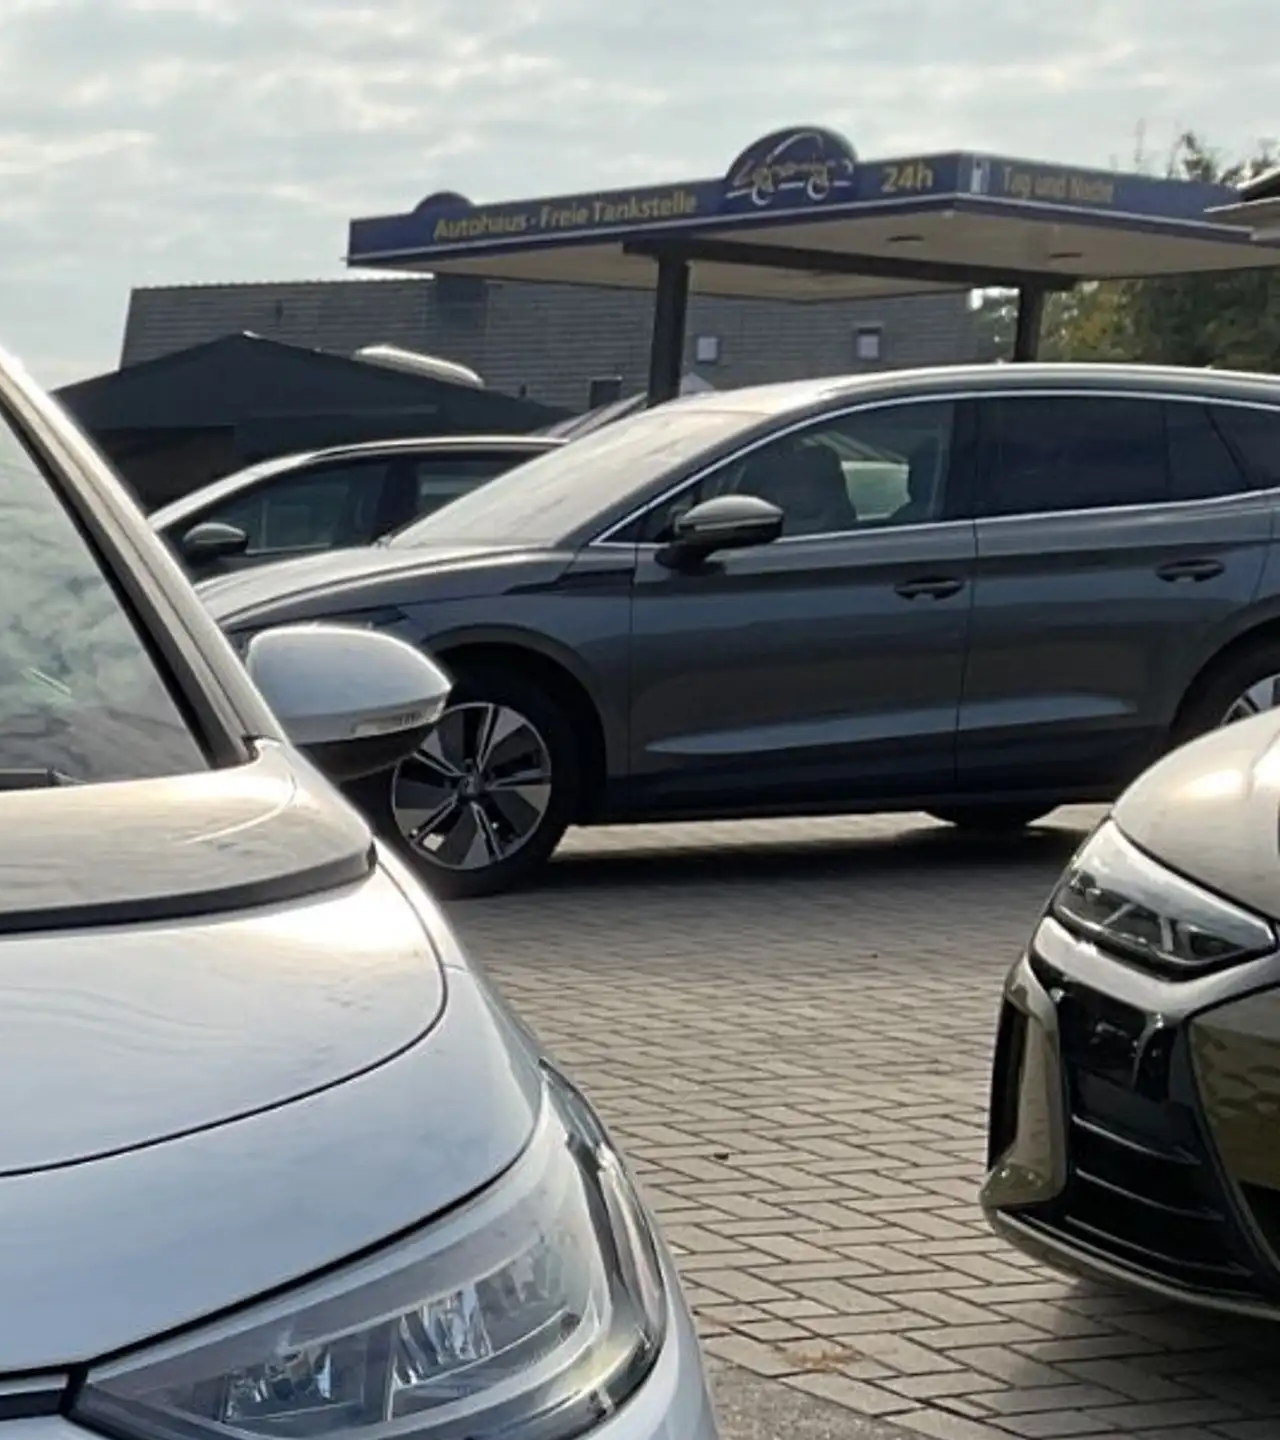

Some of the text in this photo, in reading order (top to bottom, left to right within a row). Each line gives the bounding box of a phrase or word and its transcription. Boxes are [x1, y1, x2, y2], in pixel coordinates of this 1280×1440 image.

[881, 160, 934, 193] 24h
[433, 190, 698, 241] Autohaus Freie Tankstelle
